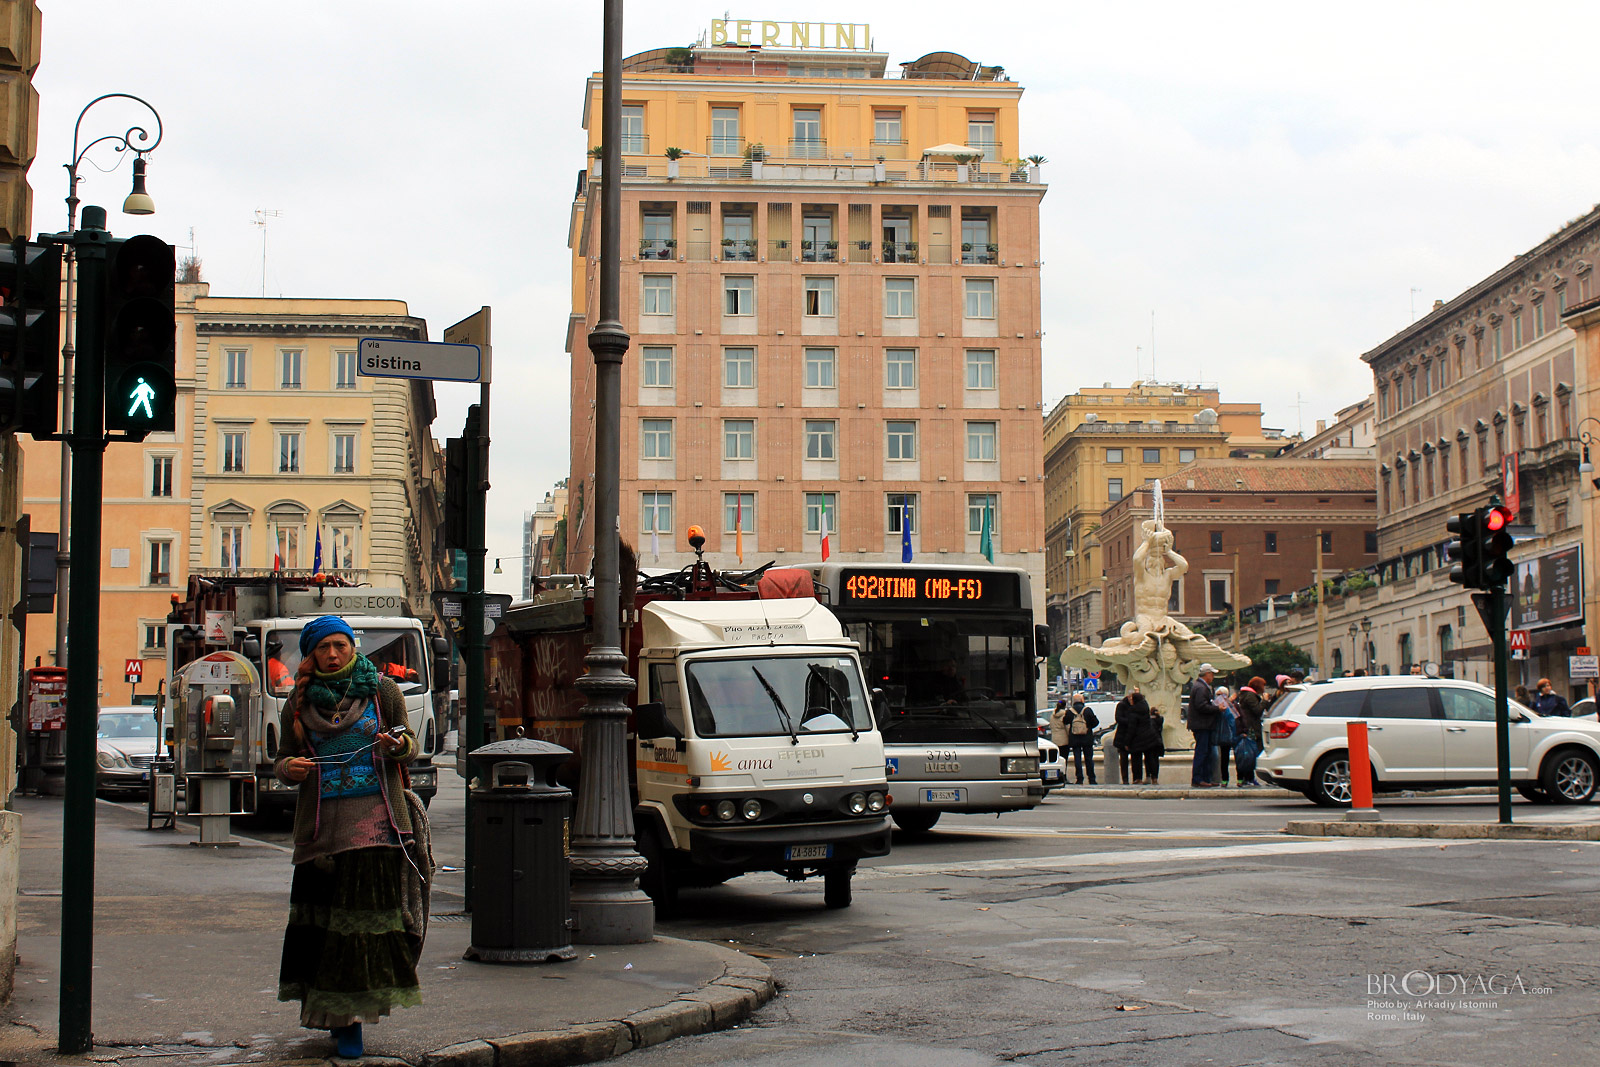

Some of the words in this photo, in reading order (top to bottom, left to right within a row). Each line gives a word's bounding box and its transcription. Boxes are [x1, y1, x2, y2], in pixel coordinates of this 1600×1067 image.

[711, 18, 870, 50] BERNINI
[367, 341, 380, 349] via
[366, 355, 422, 371] sistina
[924, 578, 983, 600] (MB-FS)
[1511, 632, 1526, 646] M
[126, 661, 142, 672] M
[778, 749, 825, 761] EFFEDI
[926, 750, 957, 761] 3791
[737, 758, 774, 771] ama
[925, 761, 961, 773] IVECO
